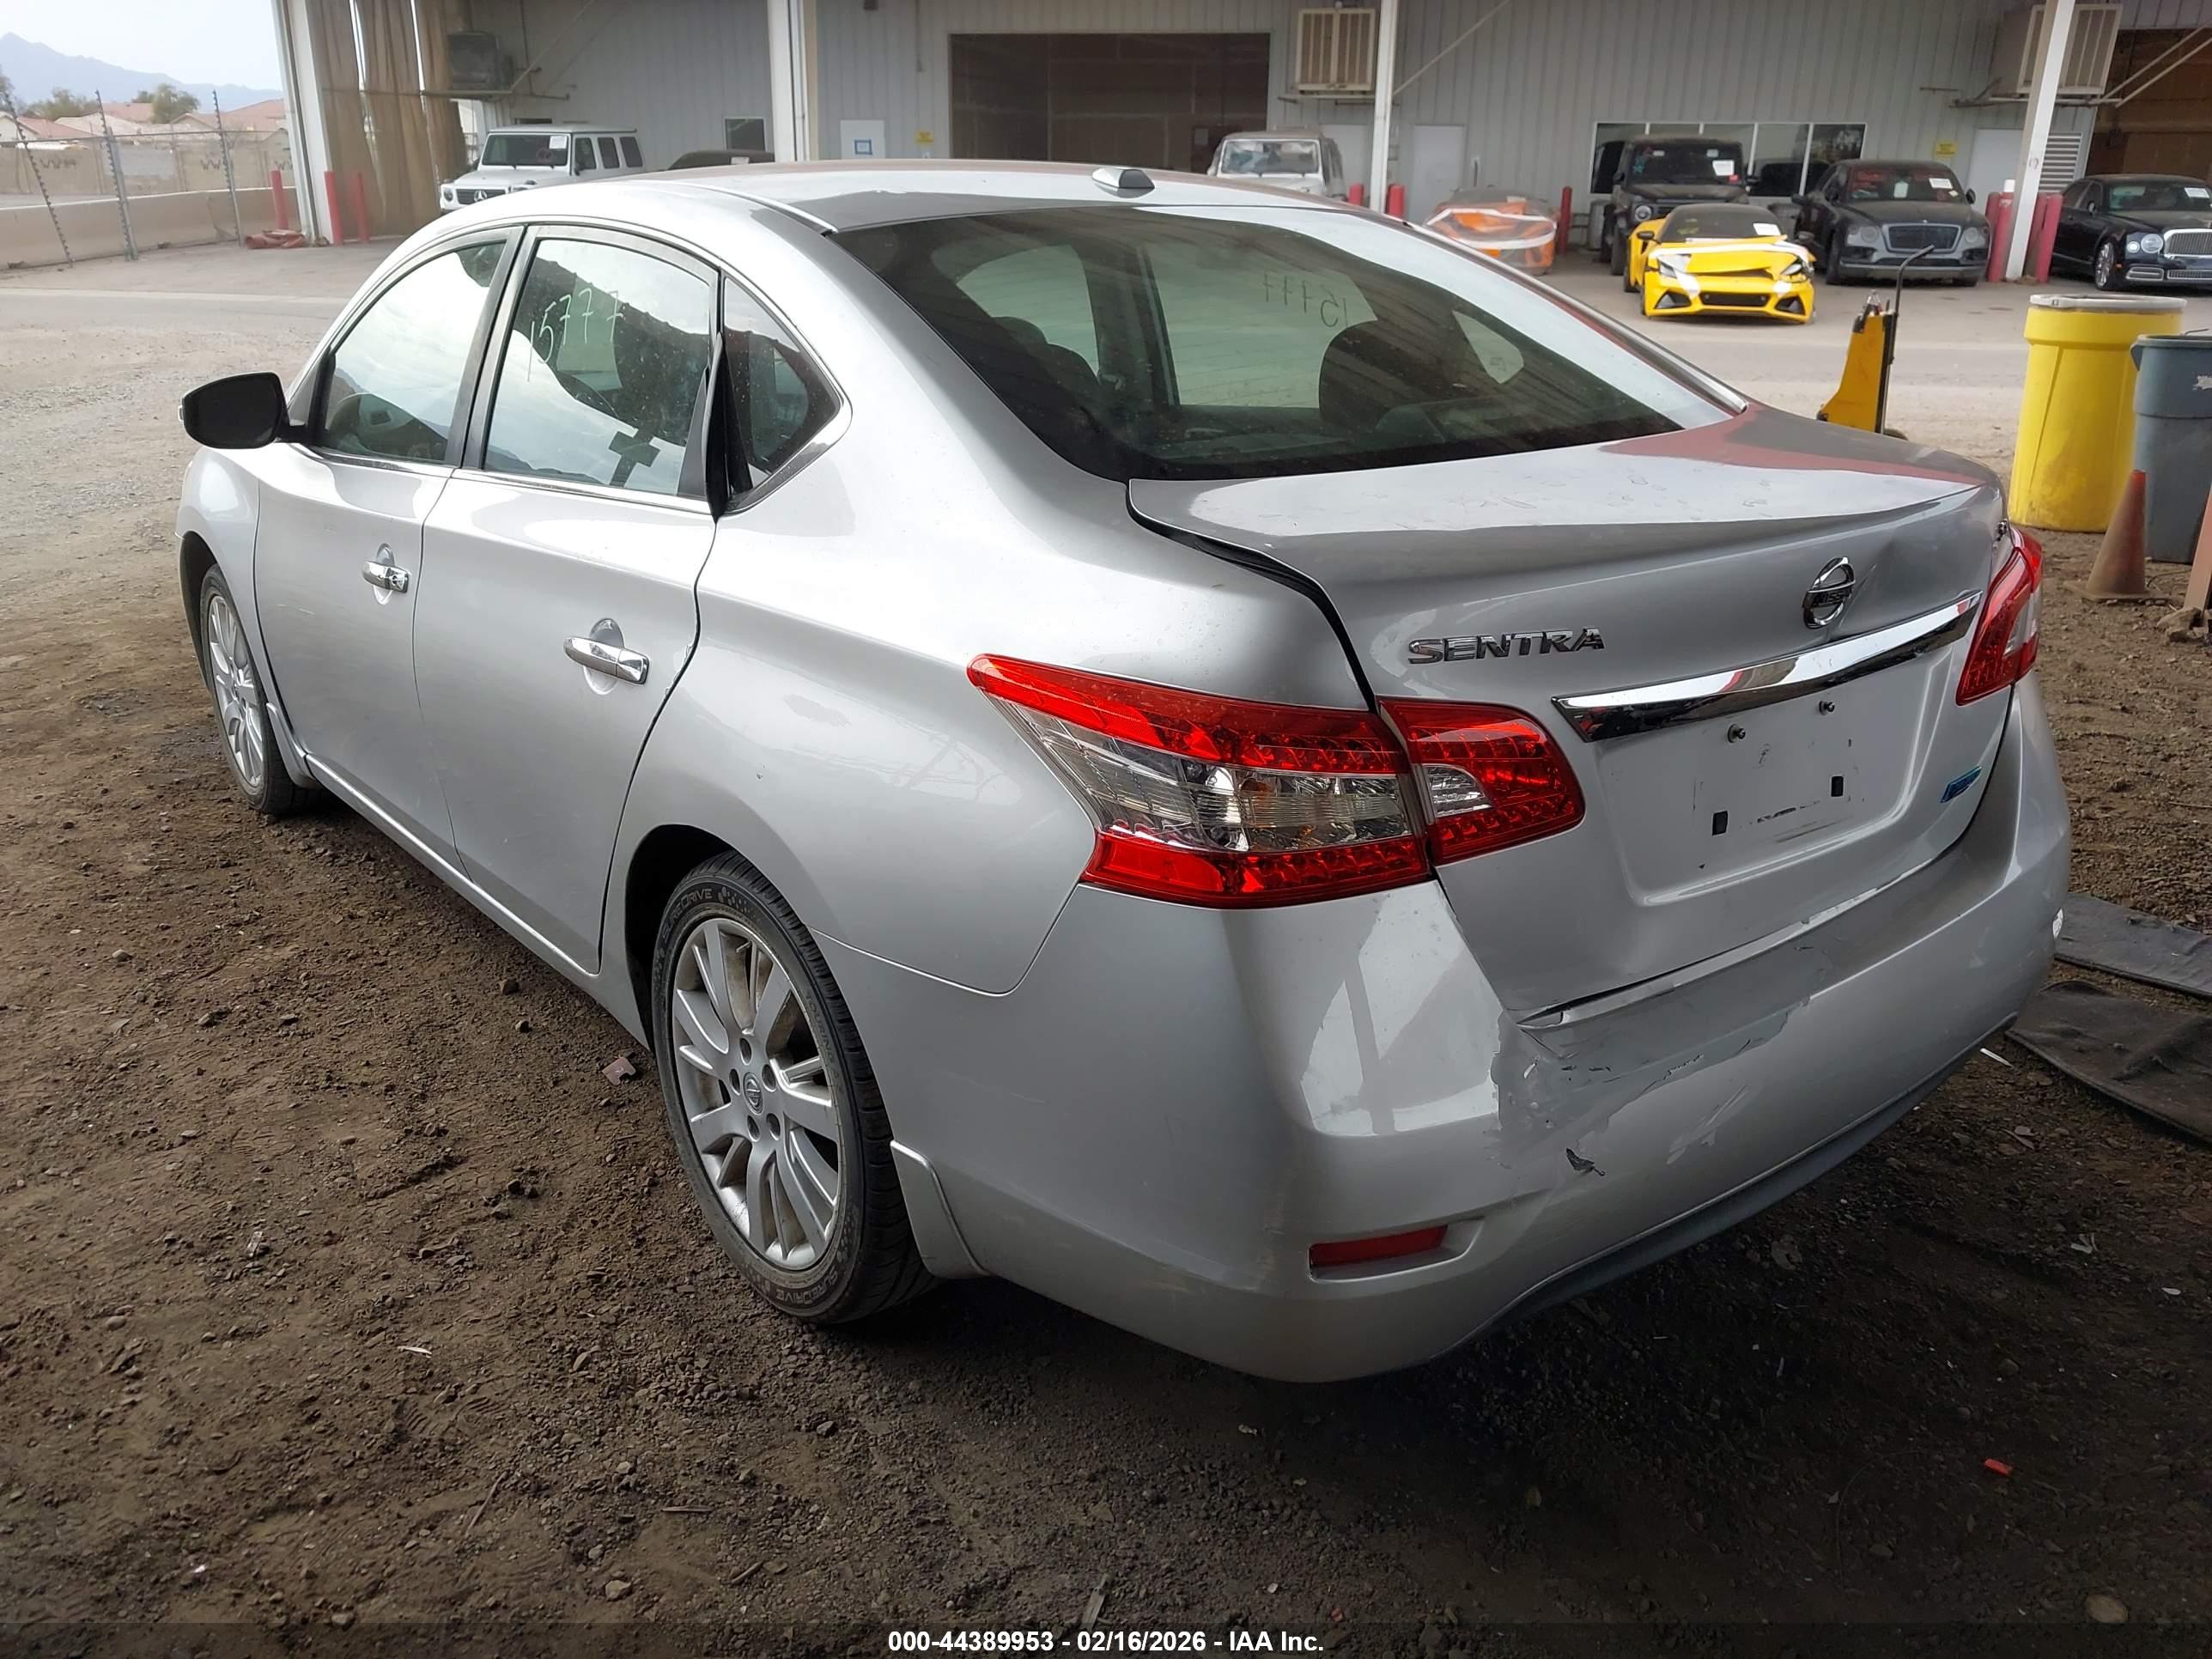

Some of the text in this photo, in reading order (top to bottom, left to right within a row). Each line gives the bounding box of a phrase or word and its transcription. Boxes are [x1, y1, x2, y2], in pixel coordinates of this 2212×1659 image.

[527, 288, 623, 382] 15777
[1408, 626, 1606, 665] SENTRA
[775, 1265, 839, 1305] SUREDRIVE
